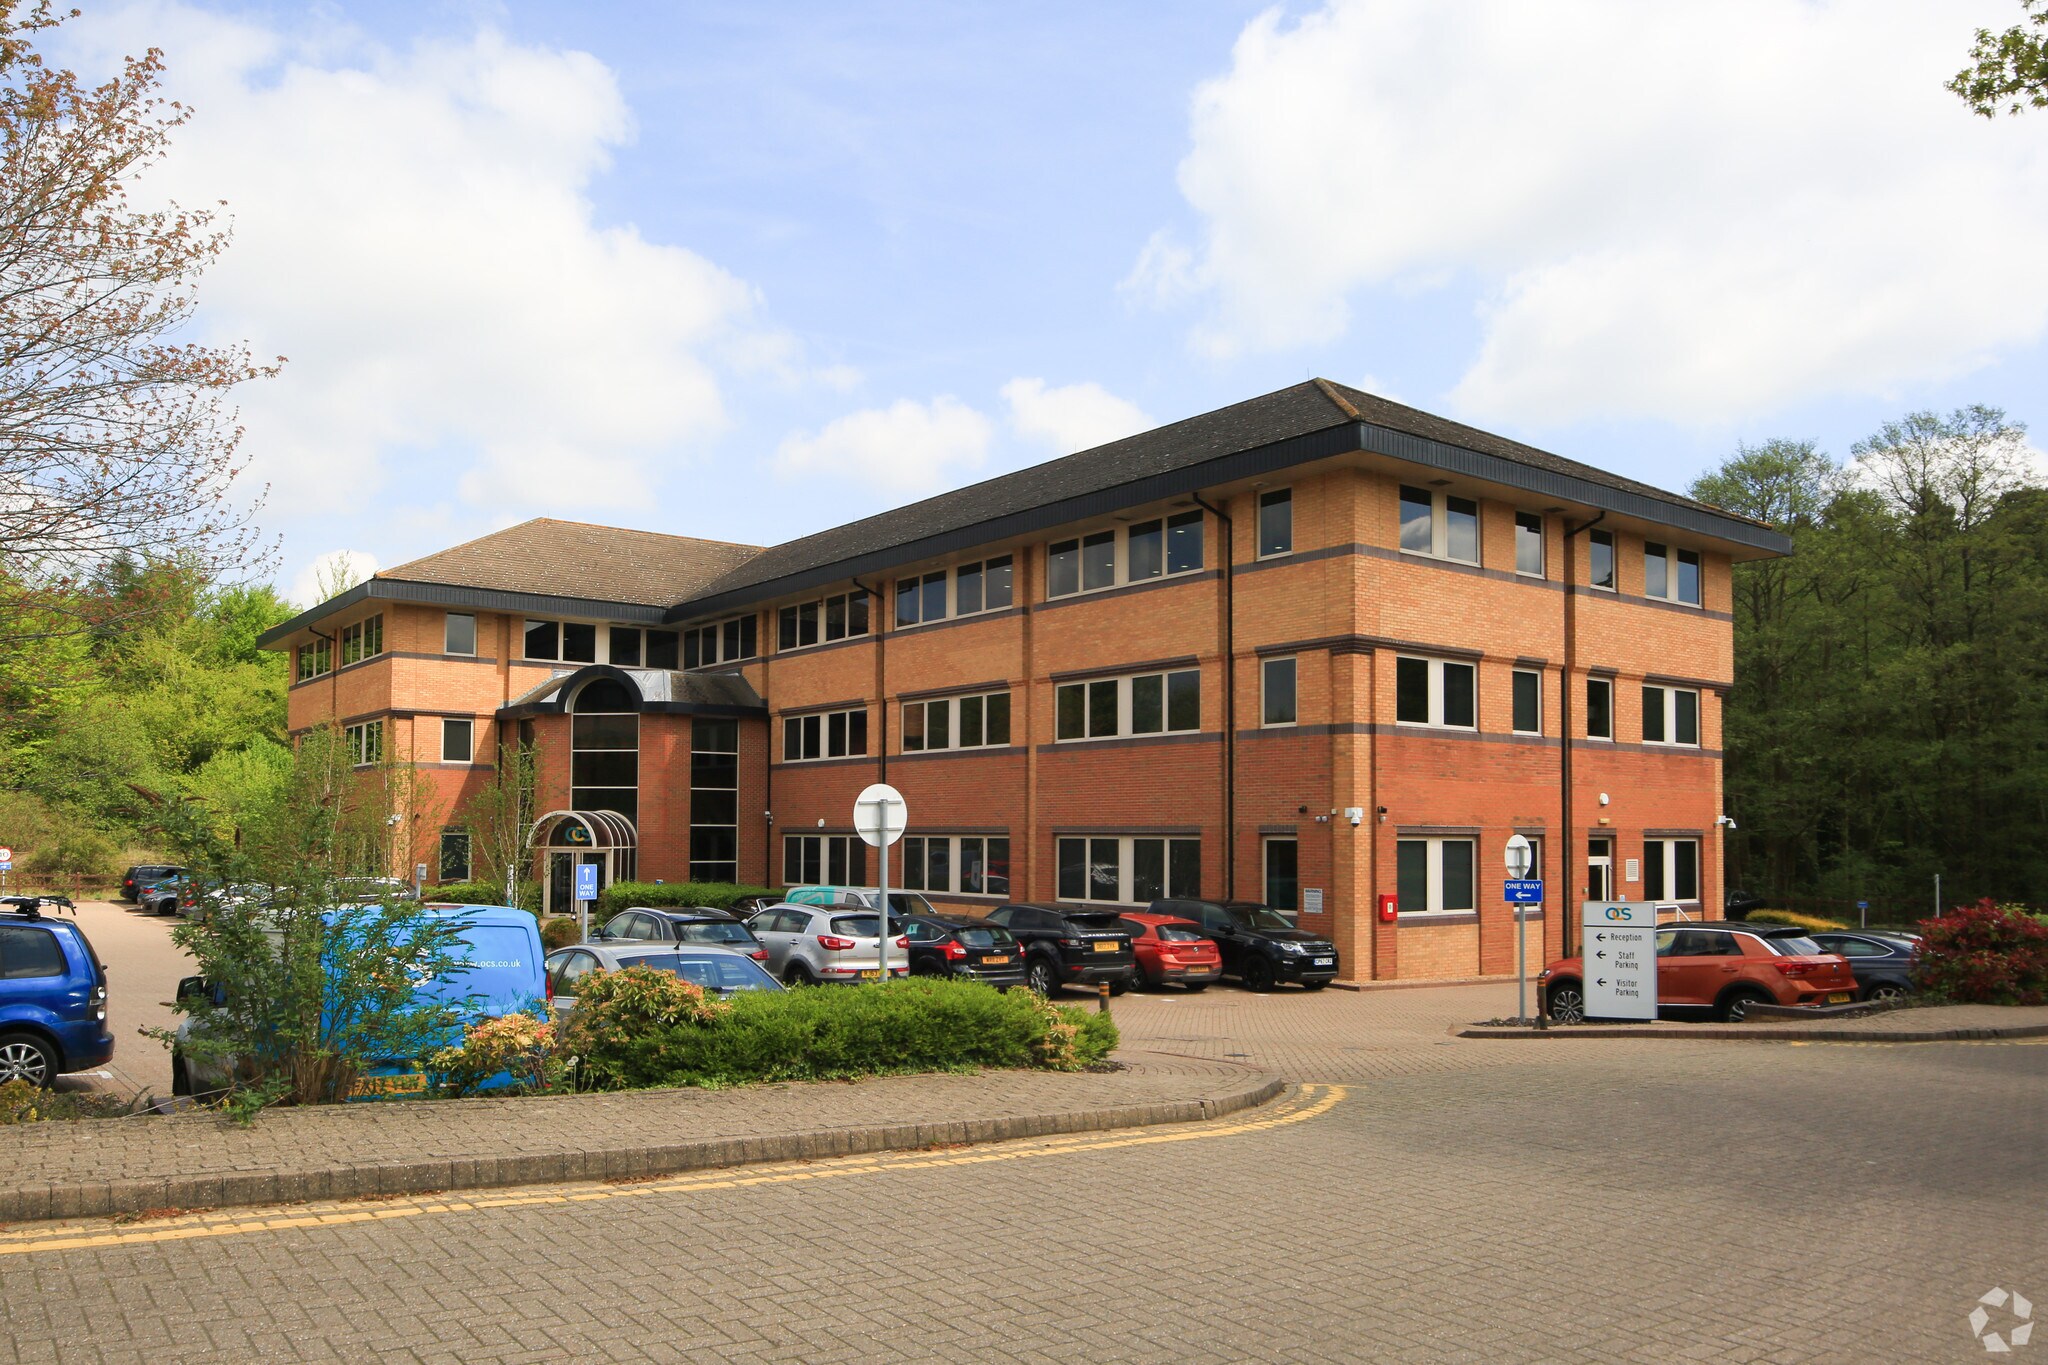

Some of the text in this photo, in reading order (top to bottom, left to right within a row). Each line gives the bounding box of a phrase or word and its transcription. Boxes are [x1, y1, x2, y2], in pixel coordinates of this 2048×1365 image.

[565, 826, 592, 842] OCS
[1605, 907, 1632, 921] OCS
[1610, 933, 1642, 942] Reception
[1618, 951, 1635, 960] Staff
[1615, 961, 1638, 970] Parking
[1616, 979, 1638, 987] Visitor
[1616, 989, 1639, 998] Parking
